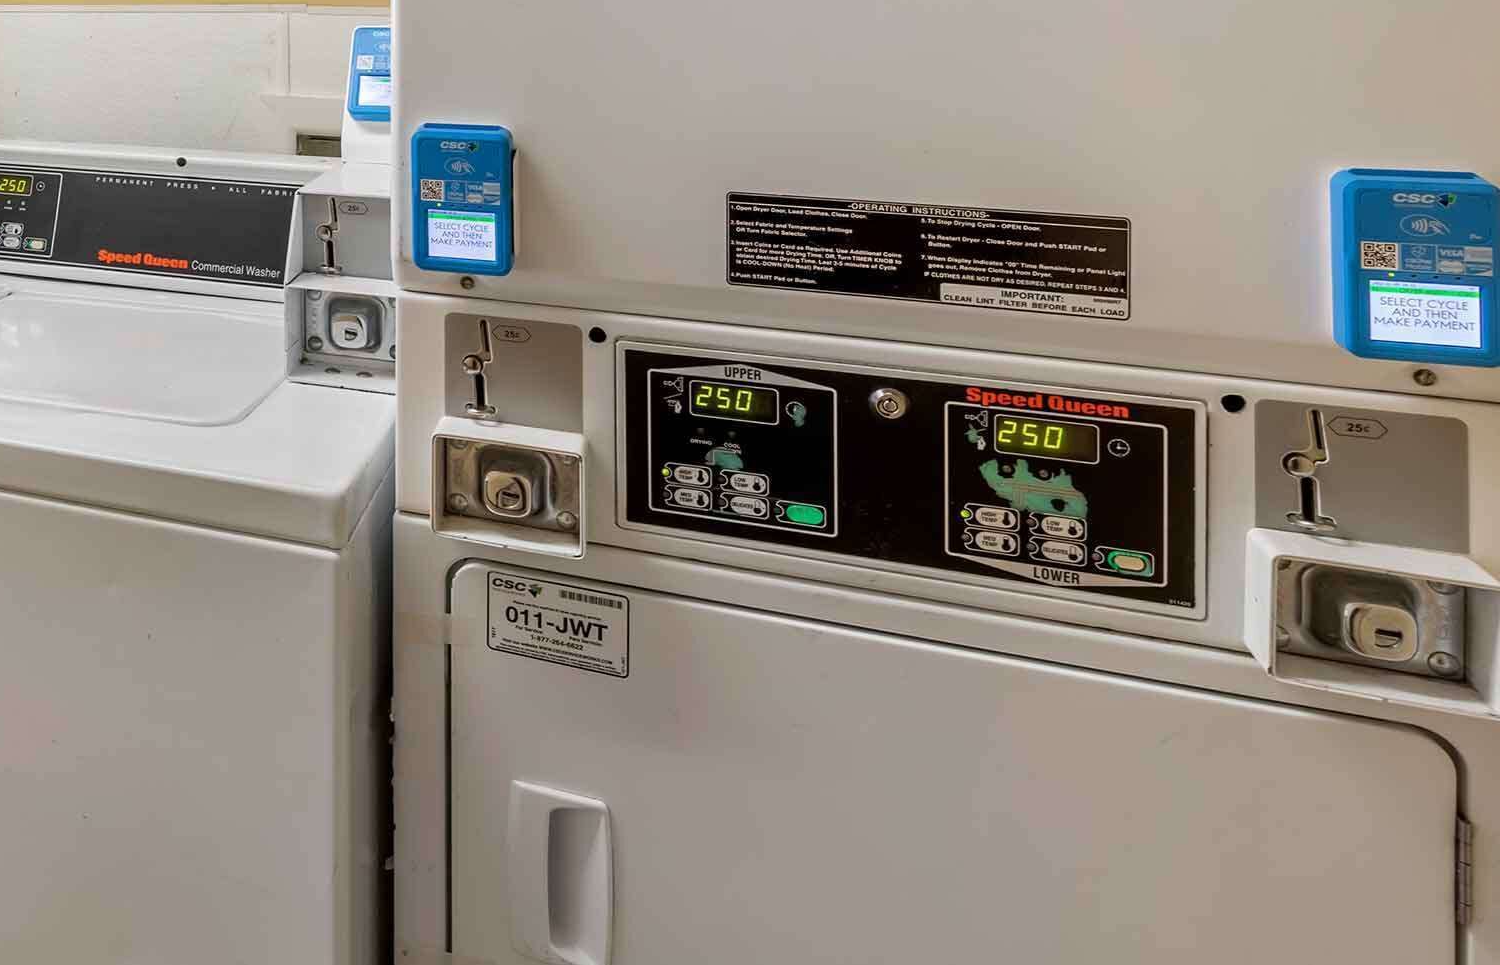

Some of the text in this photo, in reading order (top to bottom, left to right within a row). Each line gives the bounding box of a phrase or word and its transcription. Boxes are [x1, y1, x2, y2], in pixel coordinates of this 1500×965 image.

[440, 141, 467, 149] CSC
[95, 176, 155, 187] PERMANENT
[166, 181, 198, 190] PRESS
[1392, 192, 1435, 204] CSC
[434, 221, 489, 233] SELECT CYCLE
[953, 220, 975, 228] Drying
[441, 230, 483, 240] AND THEN
[962, 236, 980, 244] Dryer
[430, 236, 493, 249] MAKE PAYMENT
[97, 249, 281, 278] Speed Queen Commercial Washer
[743, 259, 782, 268] COOL-DOWN
[1038, 264, 1075, 273] Remaining
[931, 271, 960, 279] CLOTHES
[987, 267, 1013, 275] Clothes
[1001, 290, 1064, 303] IMPORTANT:
[943, 294, 1125, 317] CLEAN LINT FILTER BEFORE EACH LOAD
[1380, 296, 1469, 311] SELECT CYCLE
[1391, 307, 1458, 320] AND THEN
[1374, 316, 1476, 331] MAKE PAYMENT
[724, 366, 762, 381] UPPER
[695, 386, 752, 412] 250
[965, 386, 1130, 419] Speed Queen
[689, 438, 713, 446] DRYING
[998, 421, 1064, 450] 250
[1033, 566, 1080, 584] LOWER
[492, 578, 527, 592] CSC
[505, 606, 608, 641] 011-JWT
